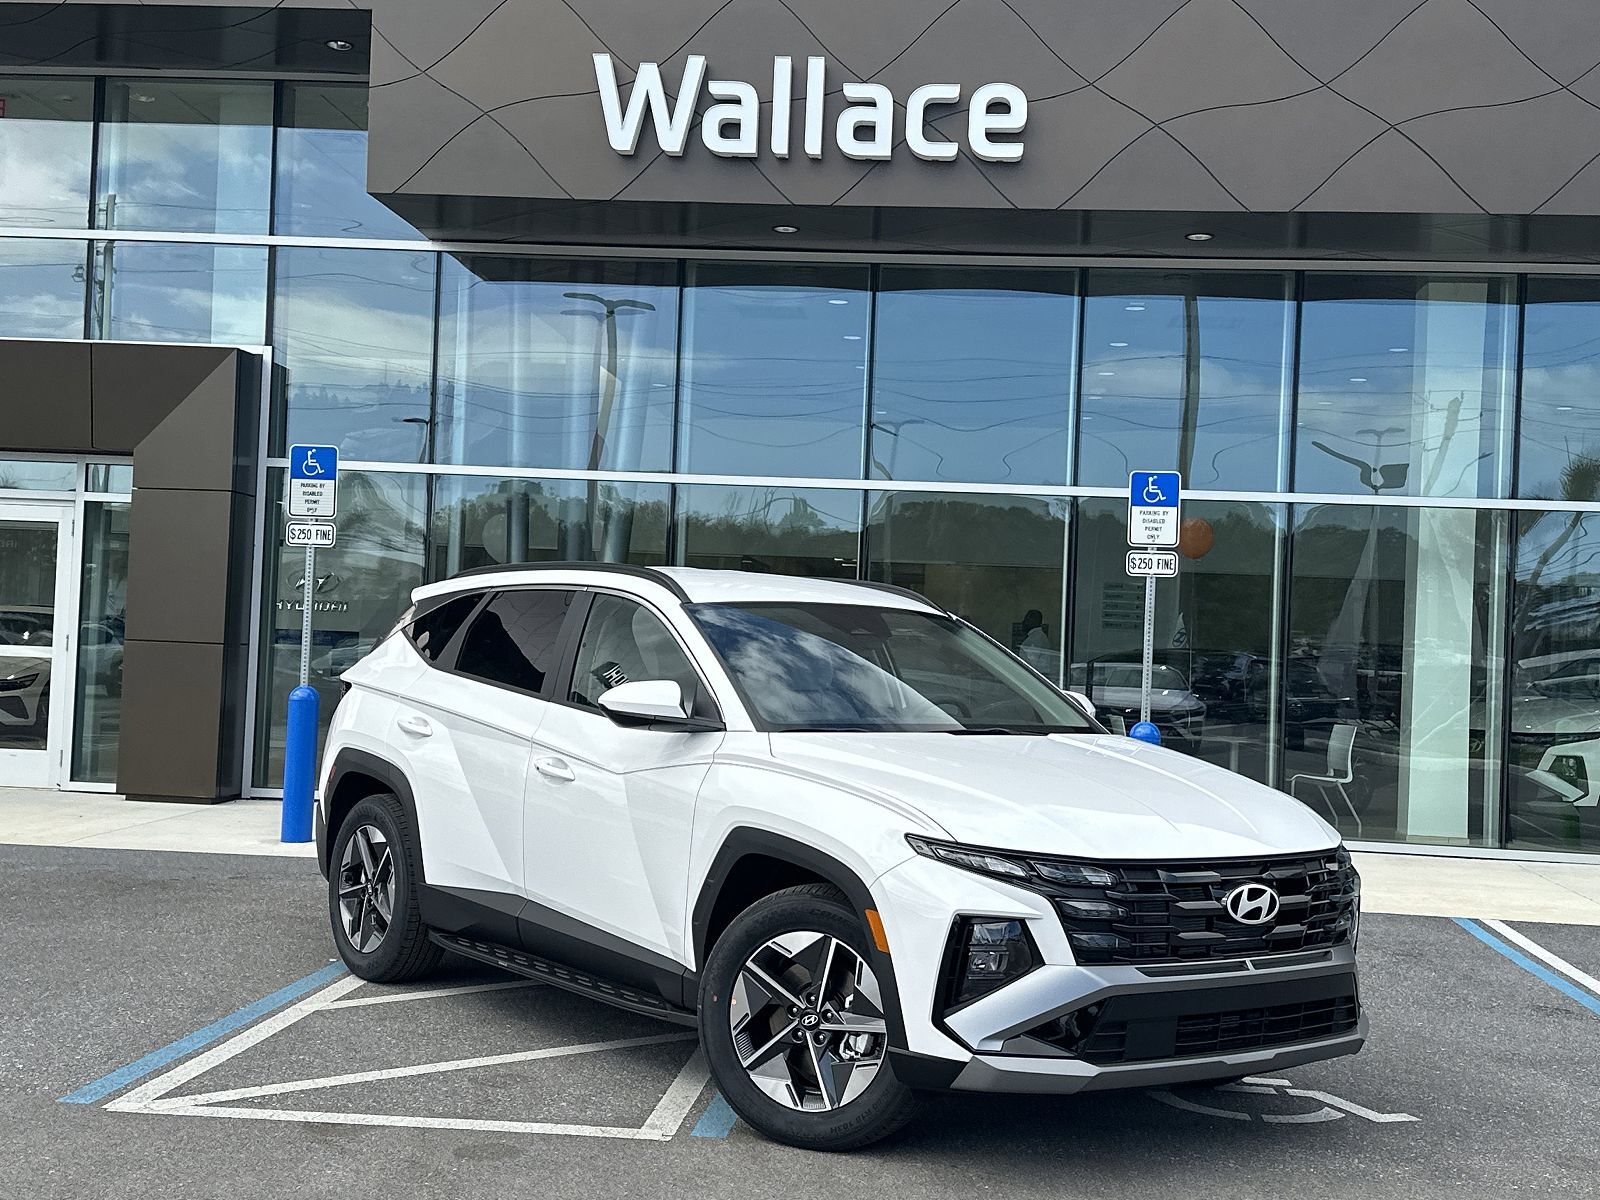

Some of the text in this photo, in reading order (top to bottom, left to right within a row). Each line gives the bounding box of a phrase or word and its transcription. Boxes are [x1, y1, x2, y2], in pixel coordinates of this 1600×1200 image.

[592, 53, 1028, 163] Wallace
[290, 528, 332, 541] $250 FINE
[1130, 556, 1174, 571] $250 FINE
